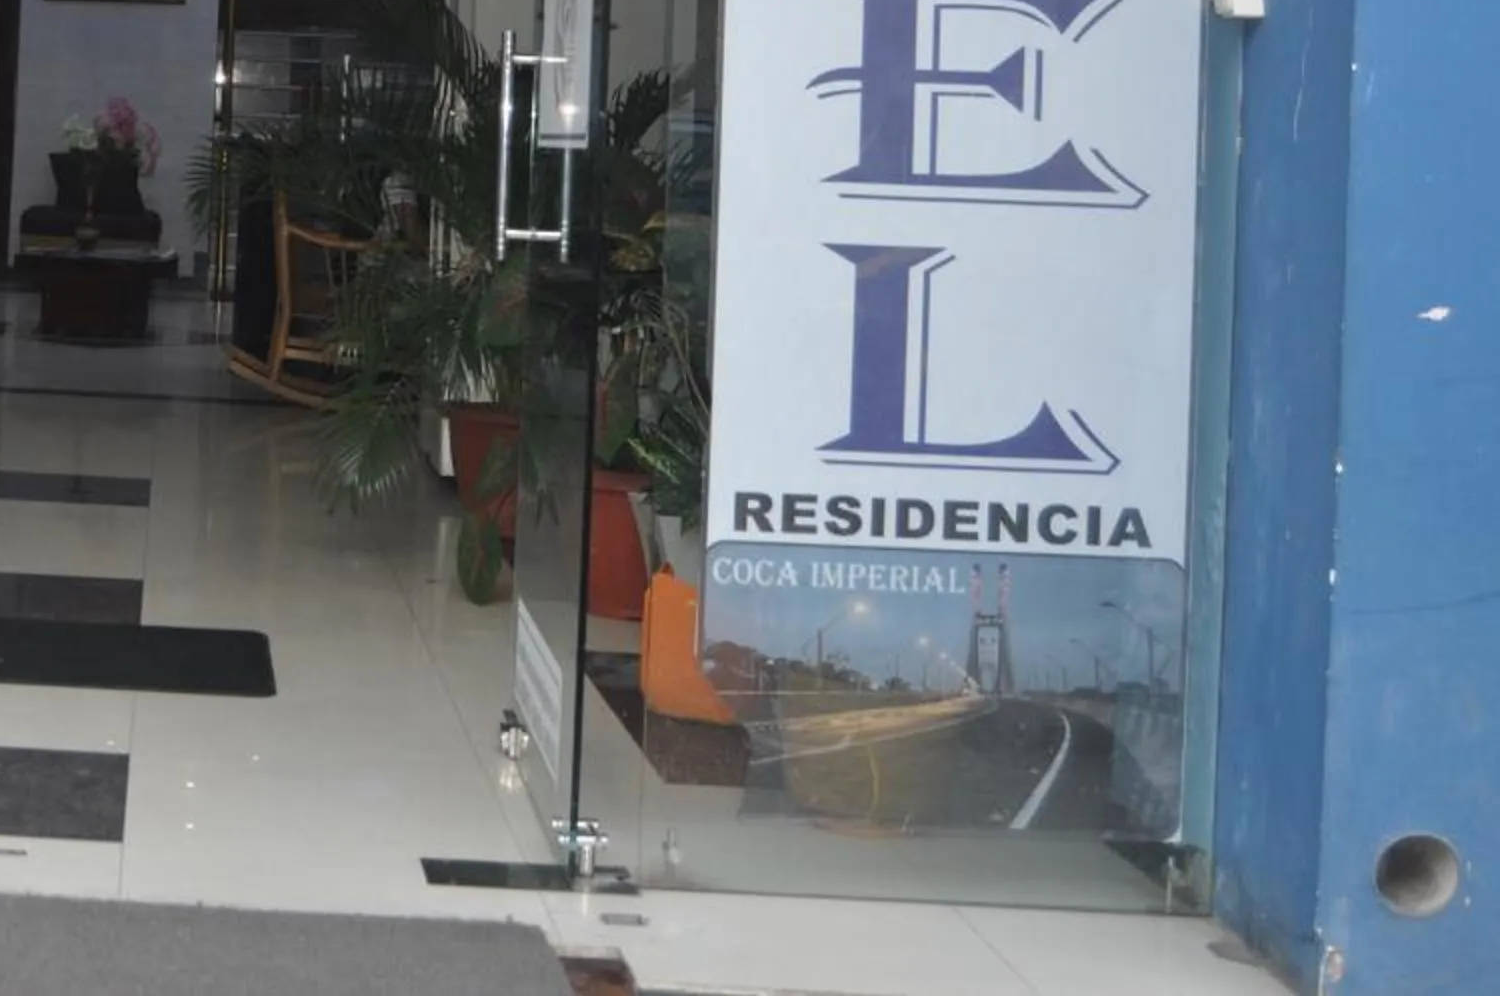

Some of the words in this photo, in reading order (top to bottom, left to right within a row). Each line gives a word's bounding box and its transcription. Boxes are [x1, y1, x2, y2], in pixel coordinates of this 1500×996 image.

[733, 491, 1152, 549] RESIDENCIA
[712, 558, 799, 588] COCA
[810, 561, 967, 594] IMPERIAL
